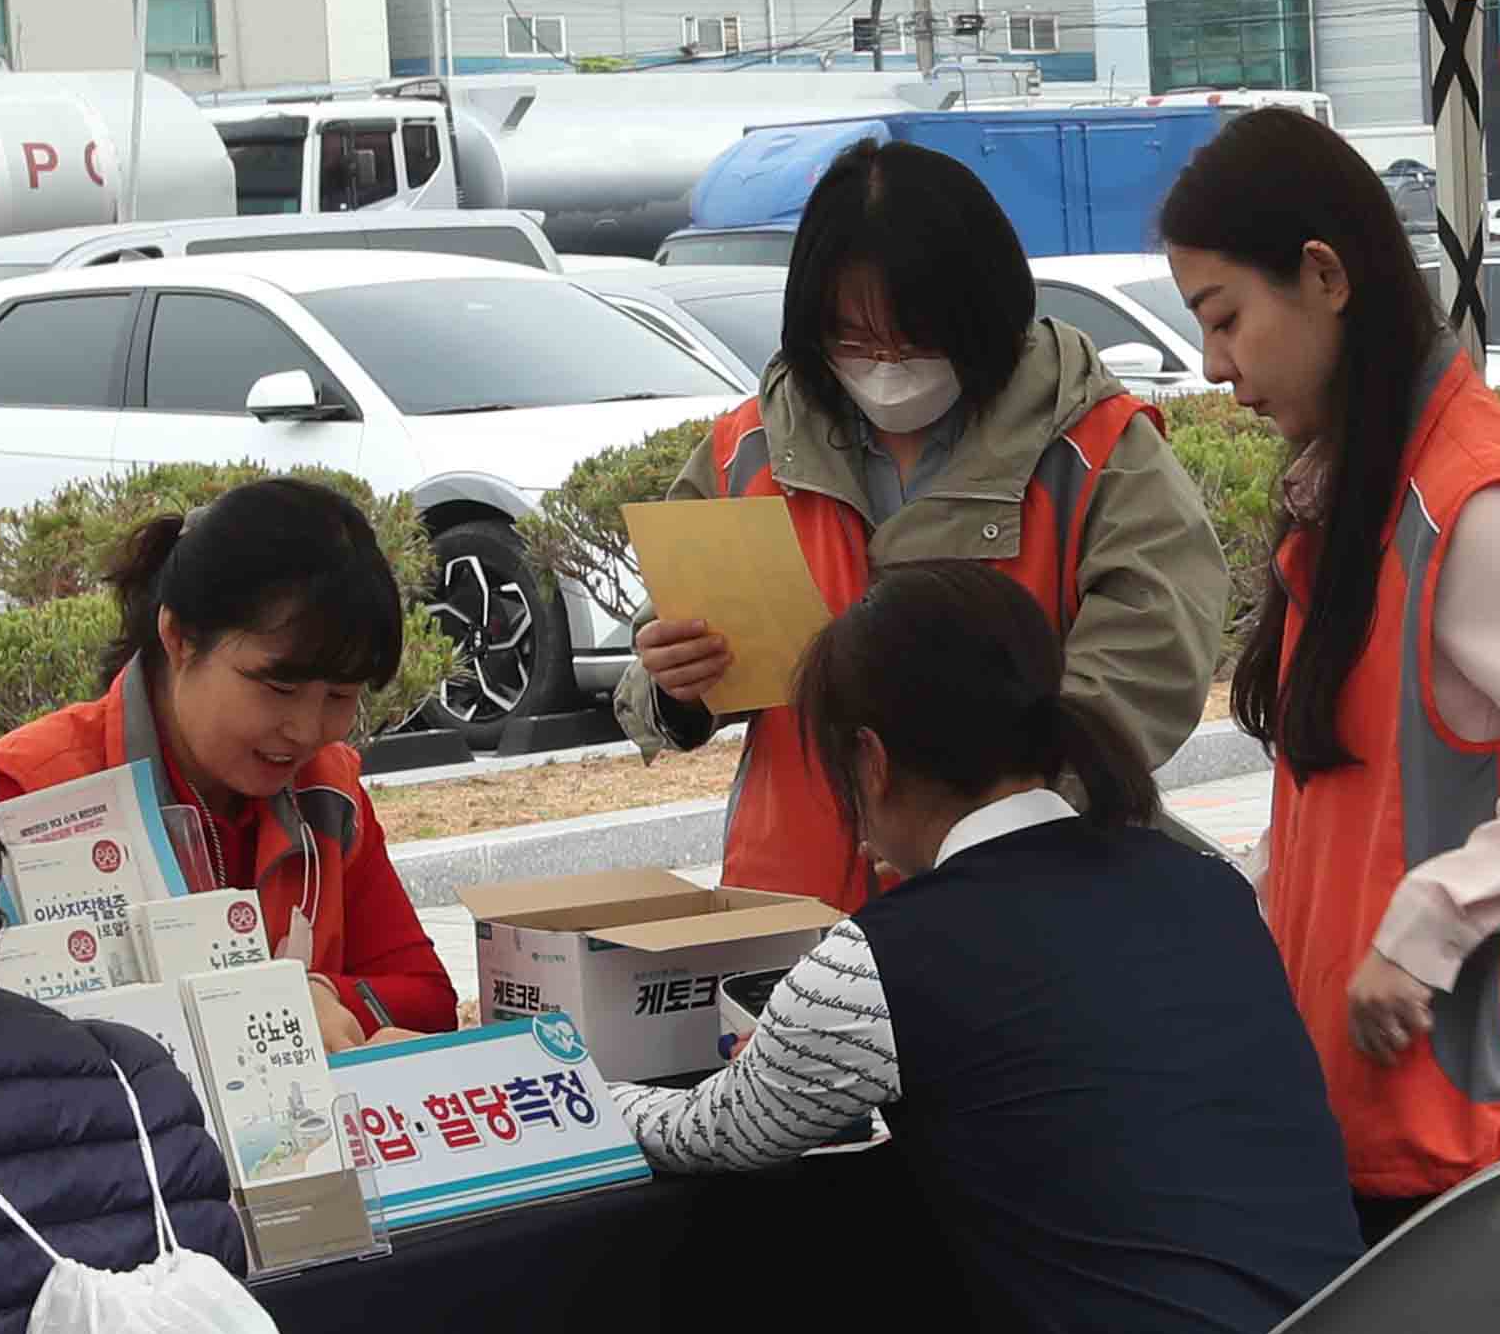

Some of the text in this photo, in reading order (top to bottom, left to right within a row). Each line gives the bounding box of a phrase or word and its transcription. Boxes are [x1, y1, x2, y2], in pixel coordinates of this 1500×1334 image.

[493, 978, 541, 1012] 케토크린
[247, 1015, 304, 1055] 당뇨병
[269, 1045, 317, 1069] 바로알기
